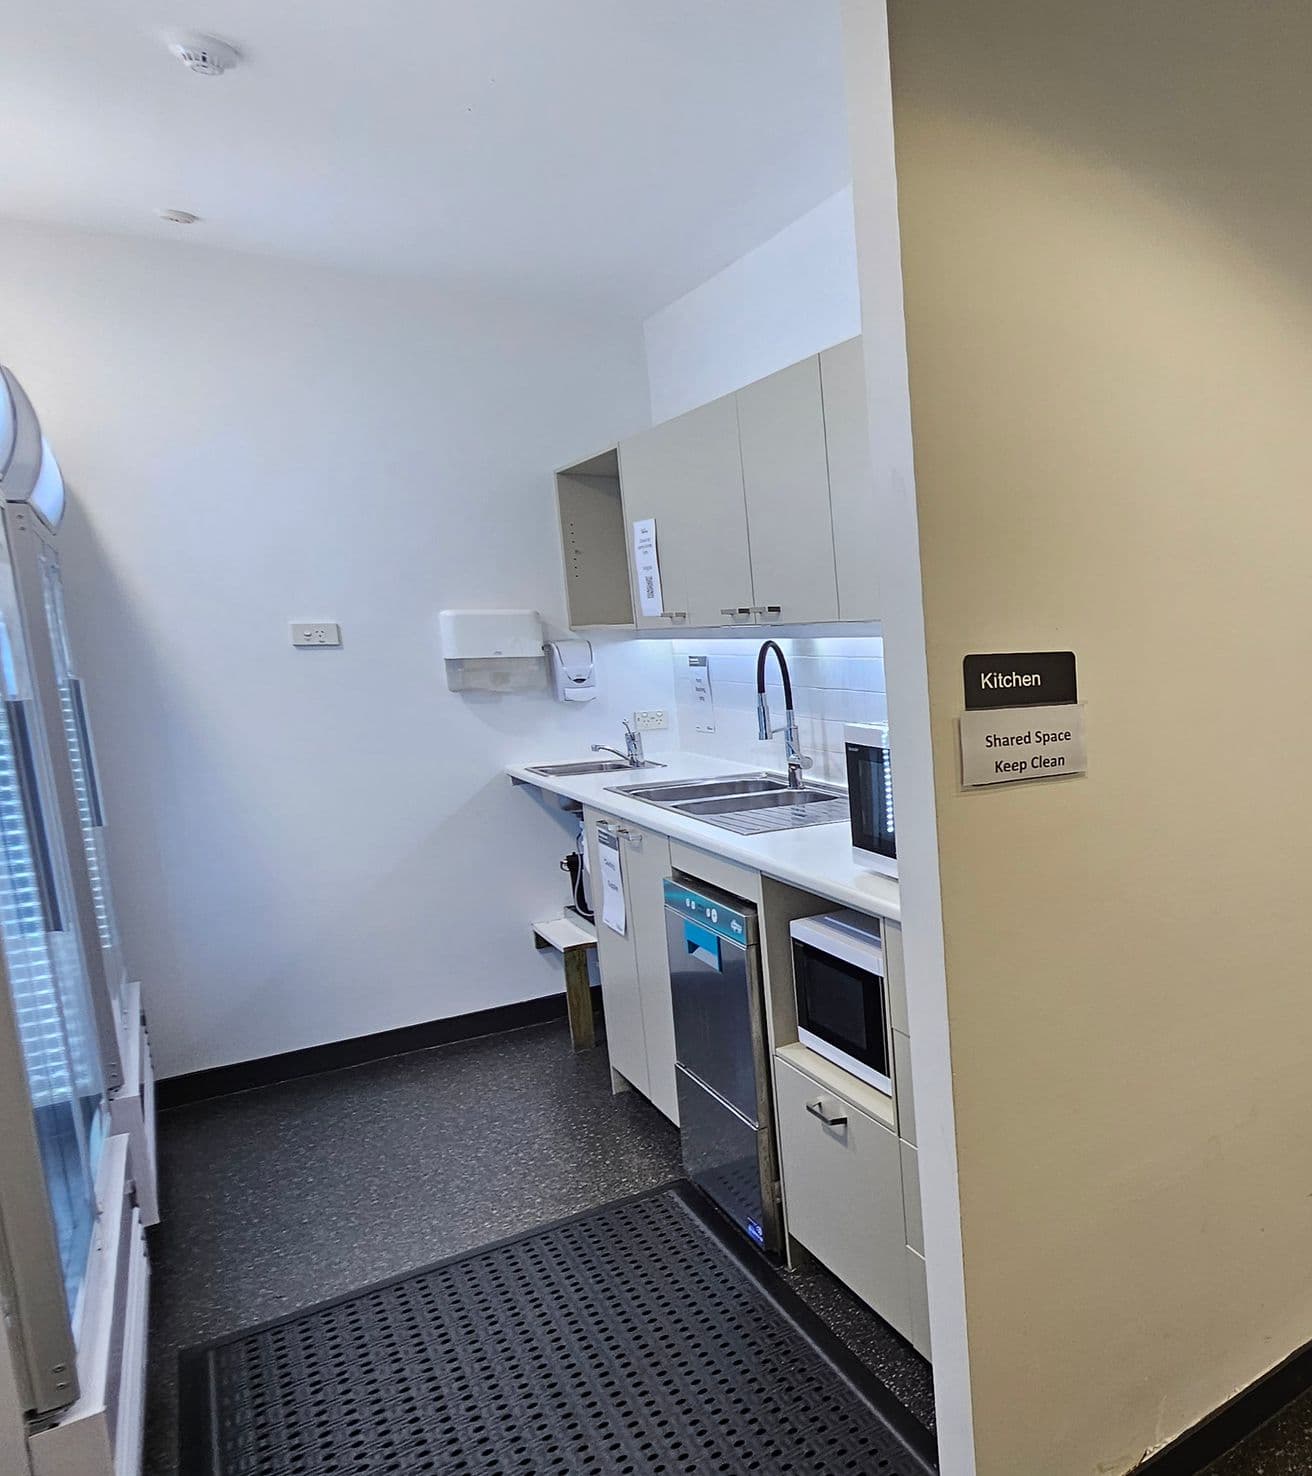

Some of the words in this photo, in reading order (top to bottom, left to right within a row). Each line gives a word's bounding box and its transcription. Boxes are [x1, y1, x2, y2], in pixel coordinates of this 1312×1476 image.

[981, 671, 1041, 689] Kitchen
[985, 731, 1031, 748] Shared
[1035, 731, 1071, 746] Space
[995, 760, 1027, 773] Keep
[1031, 755, 1065, 768] Clean
